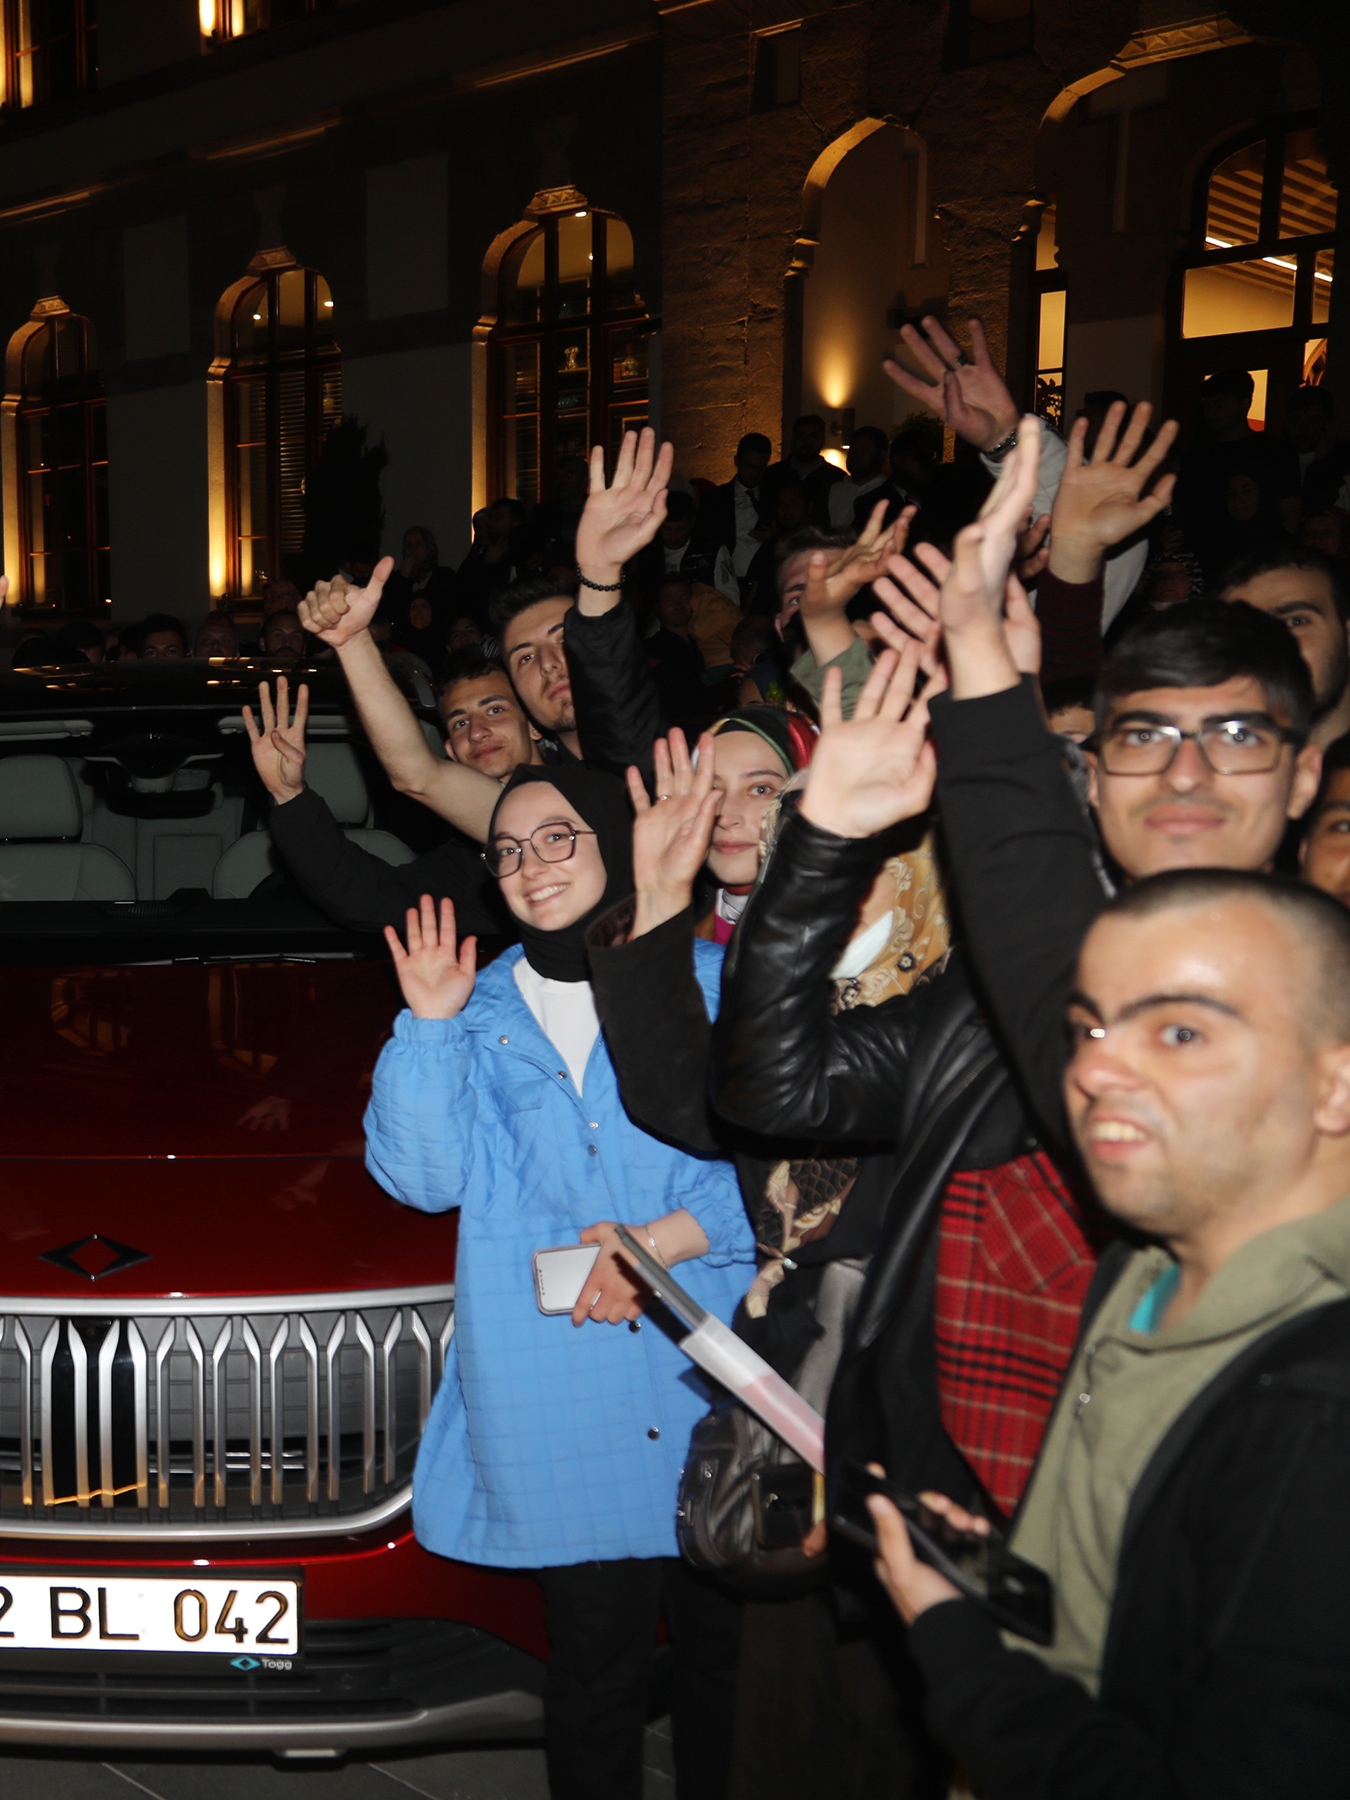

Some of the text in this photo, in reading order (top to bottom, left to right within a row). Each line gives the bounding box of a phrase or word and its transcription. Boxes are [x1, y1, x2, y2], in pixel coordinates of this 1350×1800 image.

[50, 1586, 140, 1640] BL
[173, 1589, 290, 1644] 042
[261, 1658, 293, 1671] Togg
